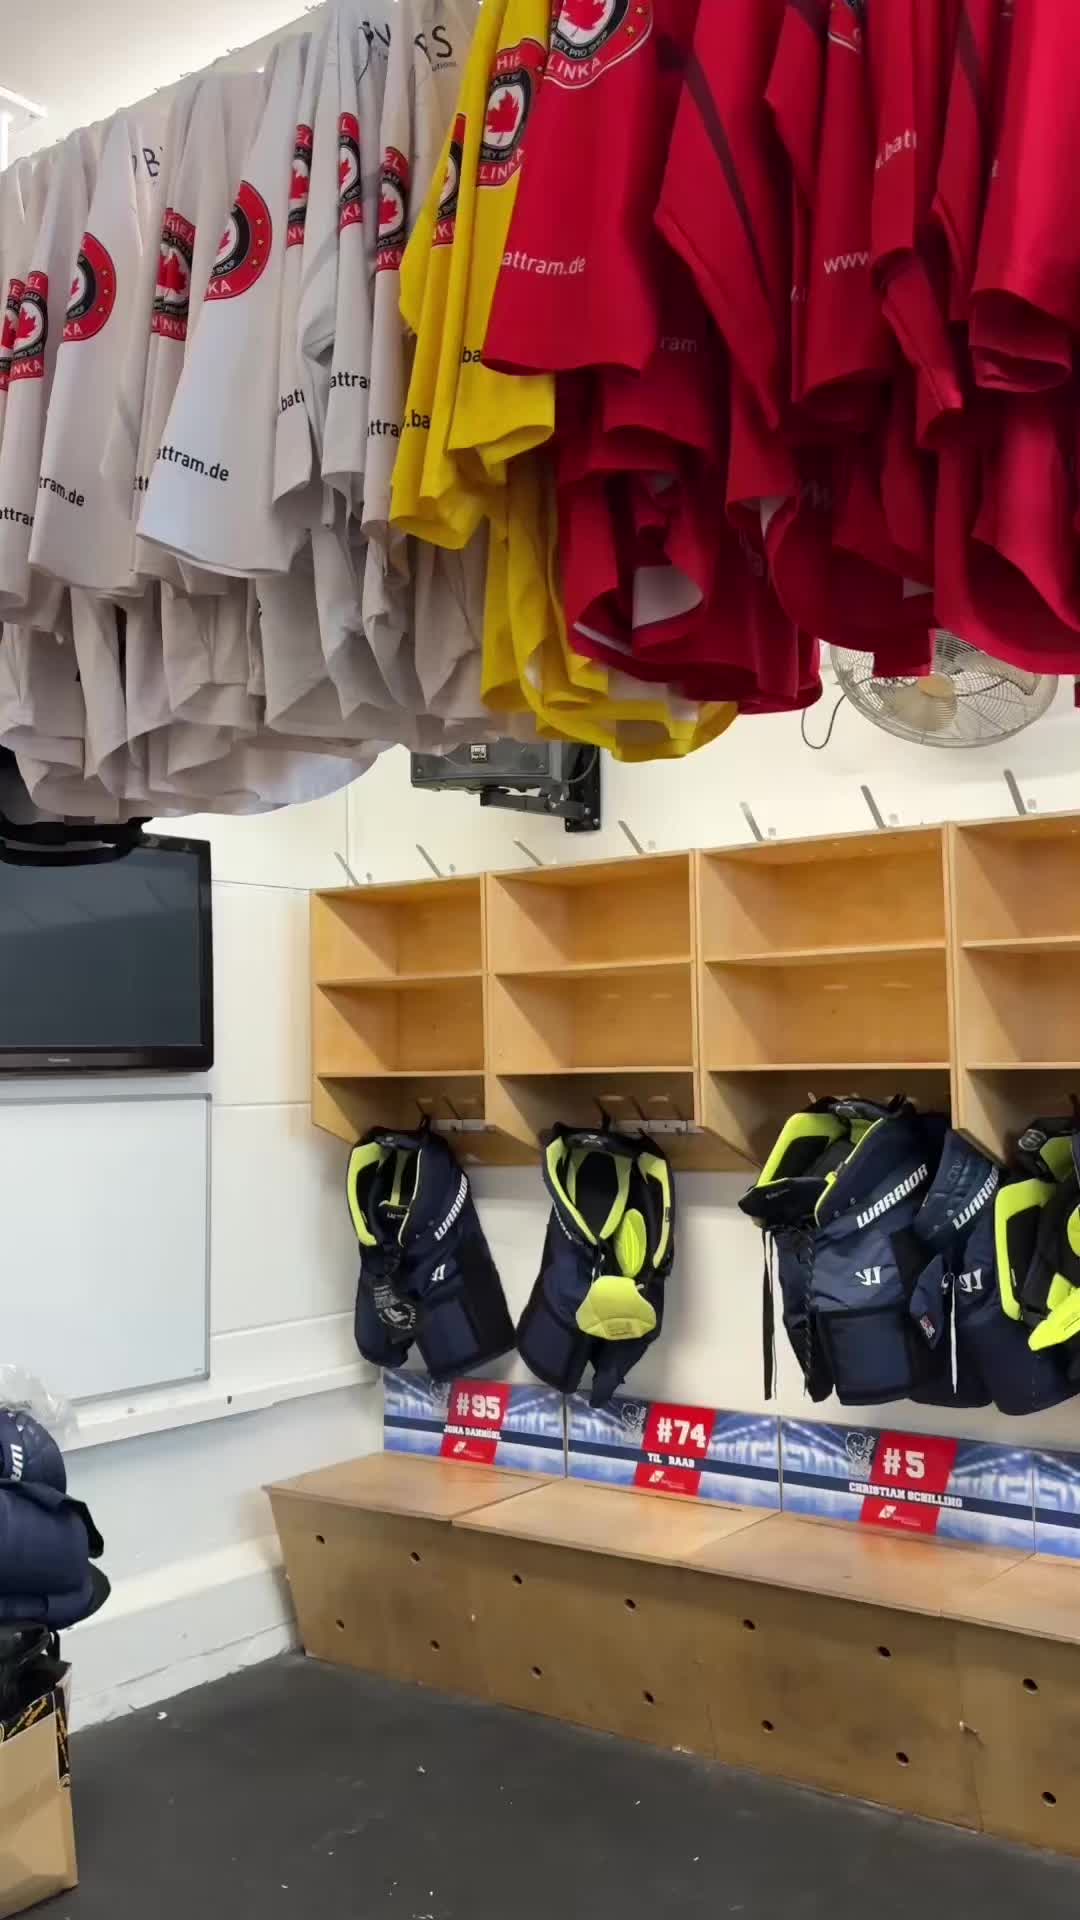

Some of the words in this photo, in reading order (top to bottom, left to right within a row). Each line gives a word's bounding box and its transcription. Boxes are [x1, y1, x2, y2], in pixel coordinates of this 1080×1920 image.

[546, 54, 601, 80] LINKA
[856, 1163, 929, 1229] WARRIOR
[456, 1392, 501, 1420] #95
[657, 1416, 706, 1448] #74
[647, 1452, 662, 1464] TIL
[668, 1455, 695, 1469] RAAB
[882, 1447, 925, 1480] #5
[849, 1481, 906, 1501] CHRISTIAN
[907, 1489, 963, 1509] SCHILLING
